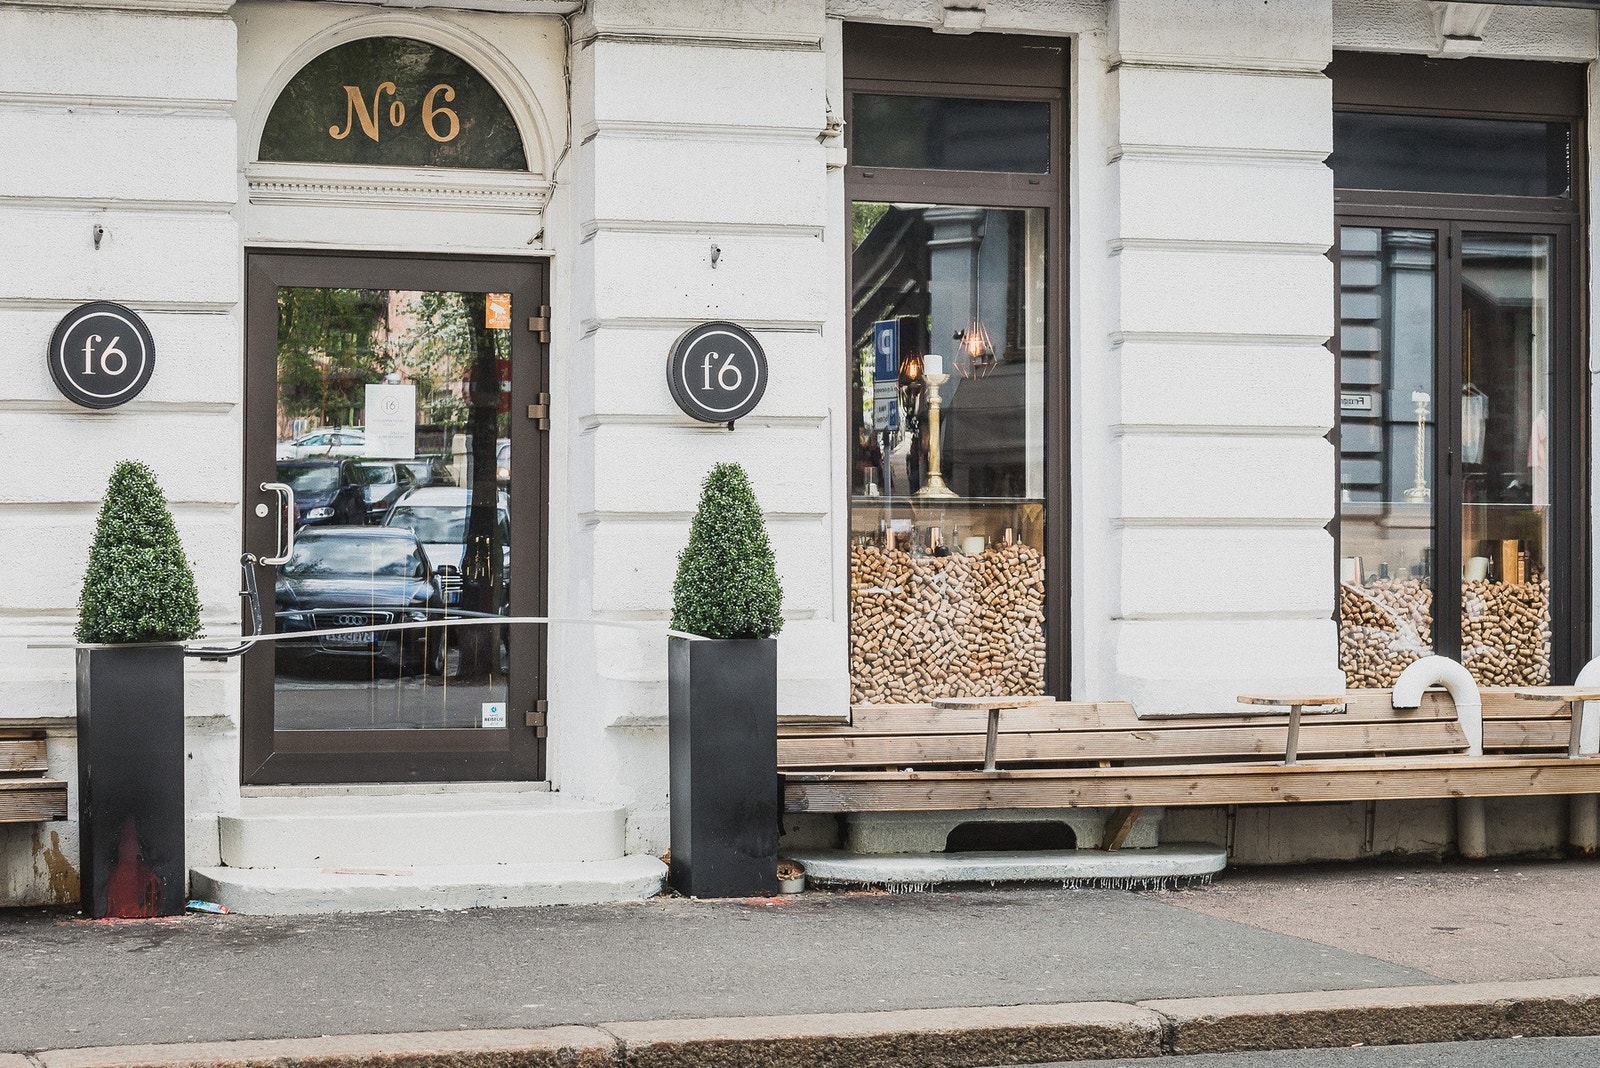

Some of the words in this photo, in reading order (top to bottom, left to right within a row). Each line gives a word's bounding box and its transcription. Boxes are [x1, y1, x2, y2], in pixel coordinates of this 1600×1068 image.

[328, 81, 406, 142] No
[421, 83, 460, 142] 6
[81, 334, 127, 376] f6
[700, 351, 742, 391] f6
